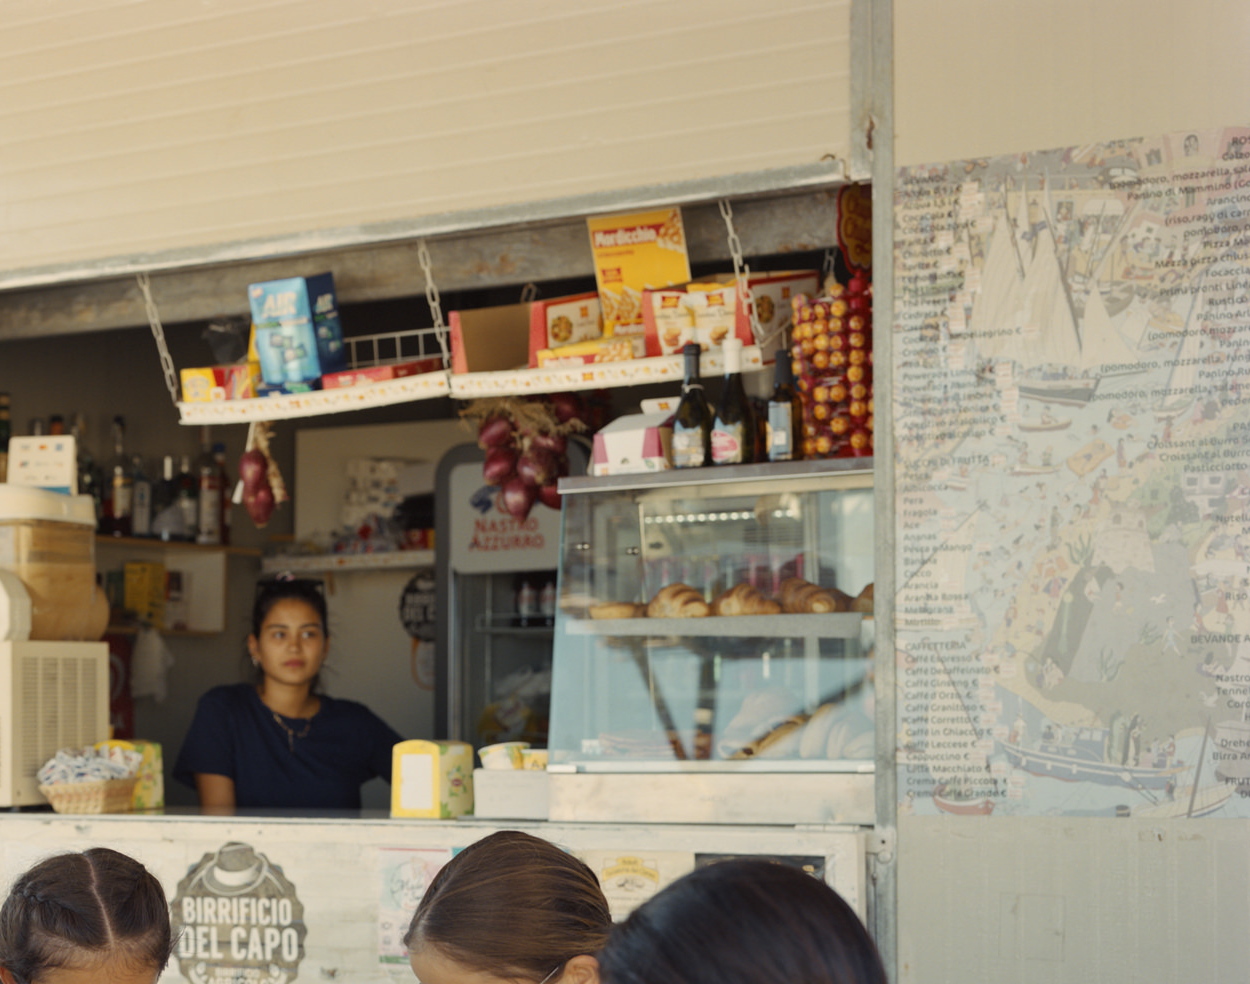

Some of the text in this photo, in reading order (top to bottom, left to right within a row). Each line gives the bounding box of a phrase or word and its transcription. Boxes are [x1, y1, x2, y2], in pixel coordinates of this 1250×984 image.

[261, 291, 297, 317] AIR
[1190, 633, 1242, 644] BEVANDE
[906, 753, 961, 763] Cappuccino
[932, 763, 982, 773] Macchiato
[181, 896, 292, 926] BIRRIFICIO
[178, 925, 299, 962] DEL CAPO
